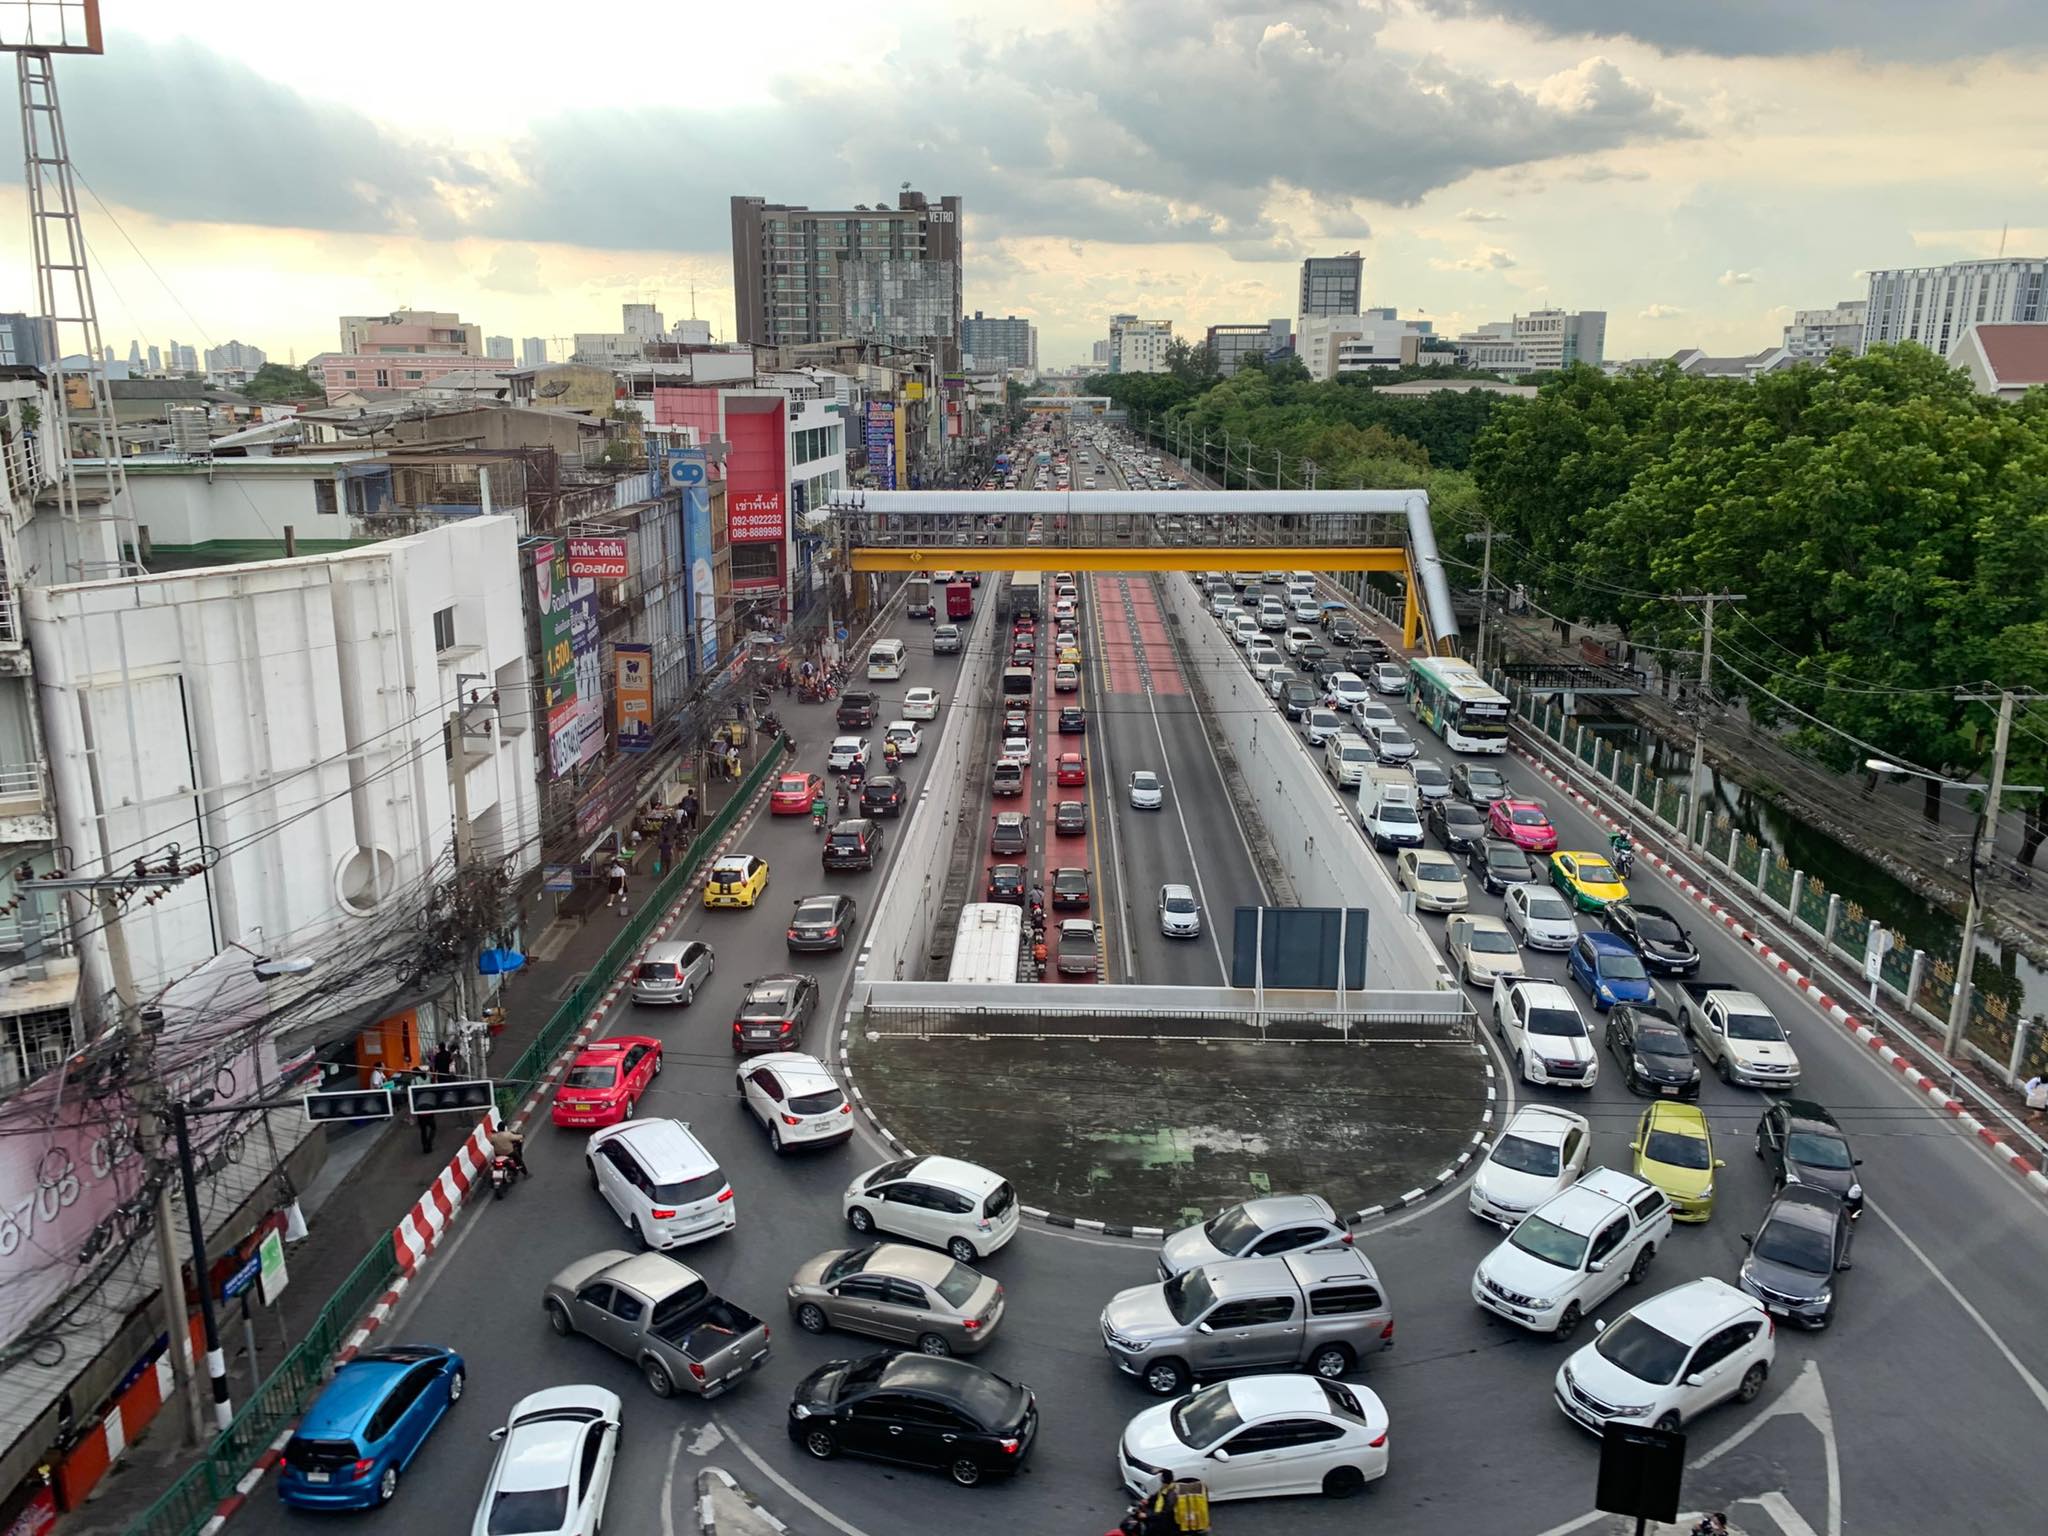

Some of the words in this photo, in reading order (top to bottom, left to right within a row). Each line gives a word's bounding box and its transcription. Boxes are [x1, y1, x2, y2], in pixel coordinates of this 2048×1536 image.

[928, 211, 954, 223] VETRO
[736, 494, 778, 511] เช่าพื้นที่
[732, 514, 782, 526] 092-9022232
